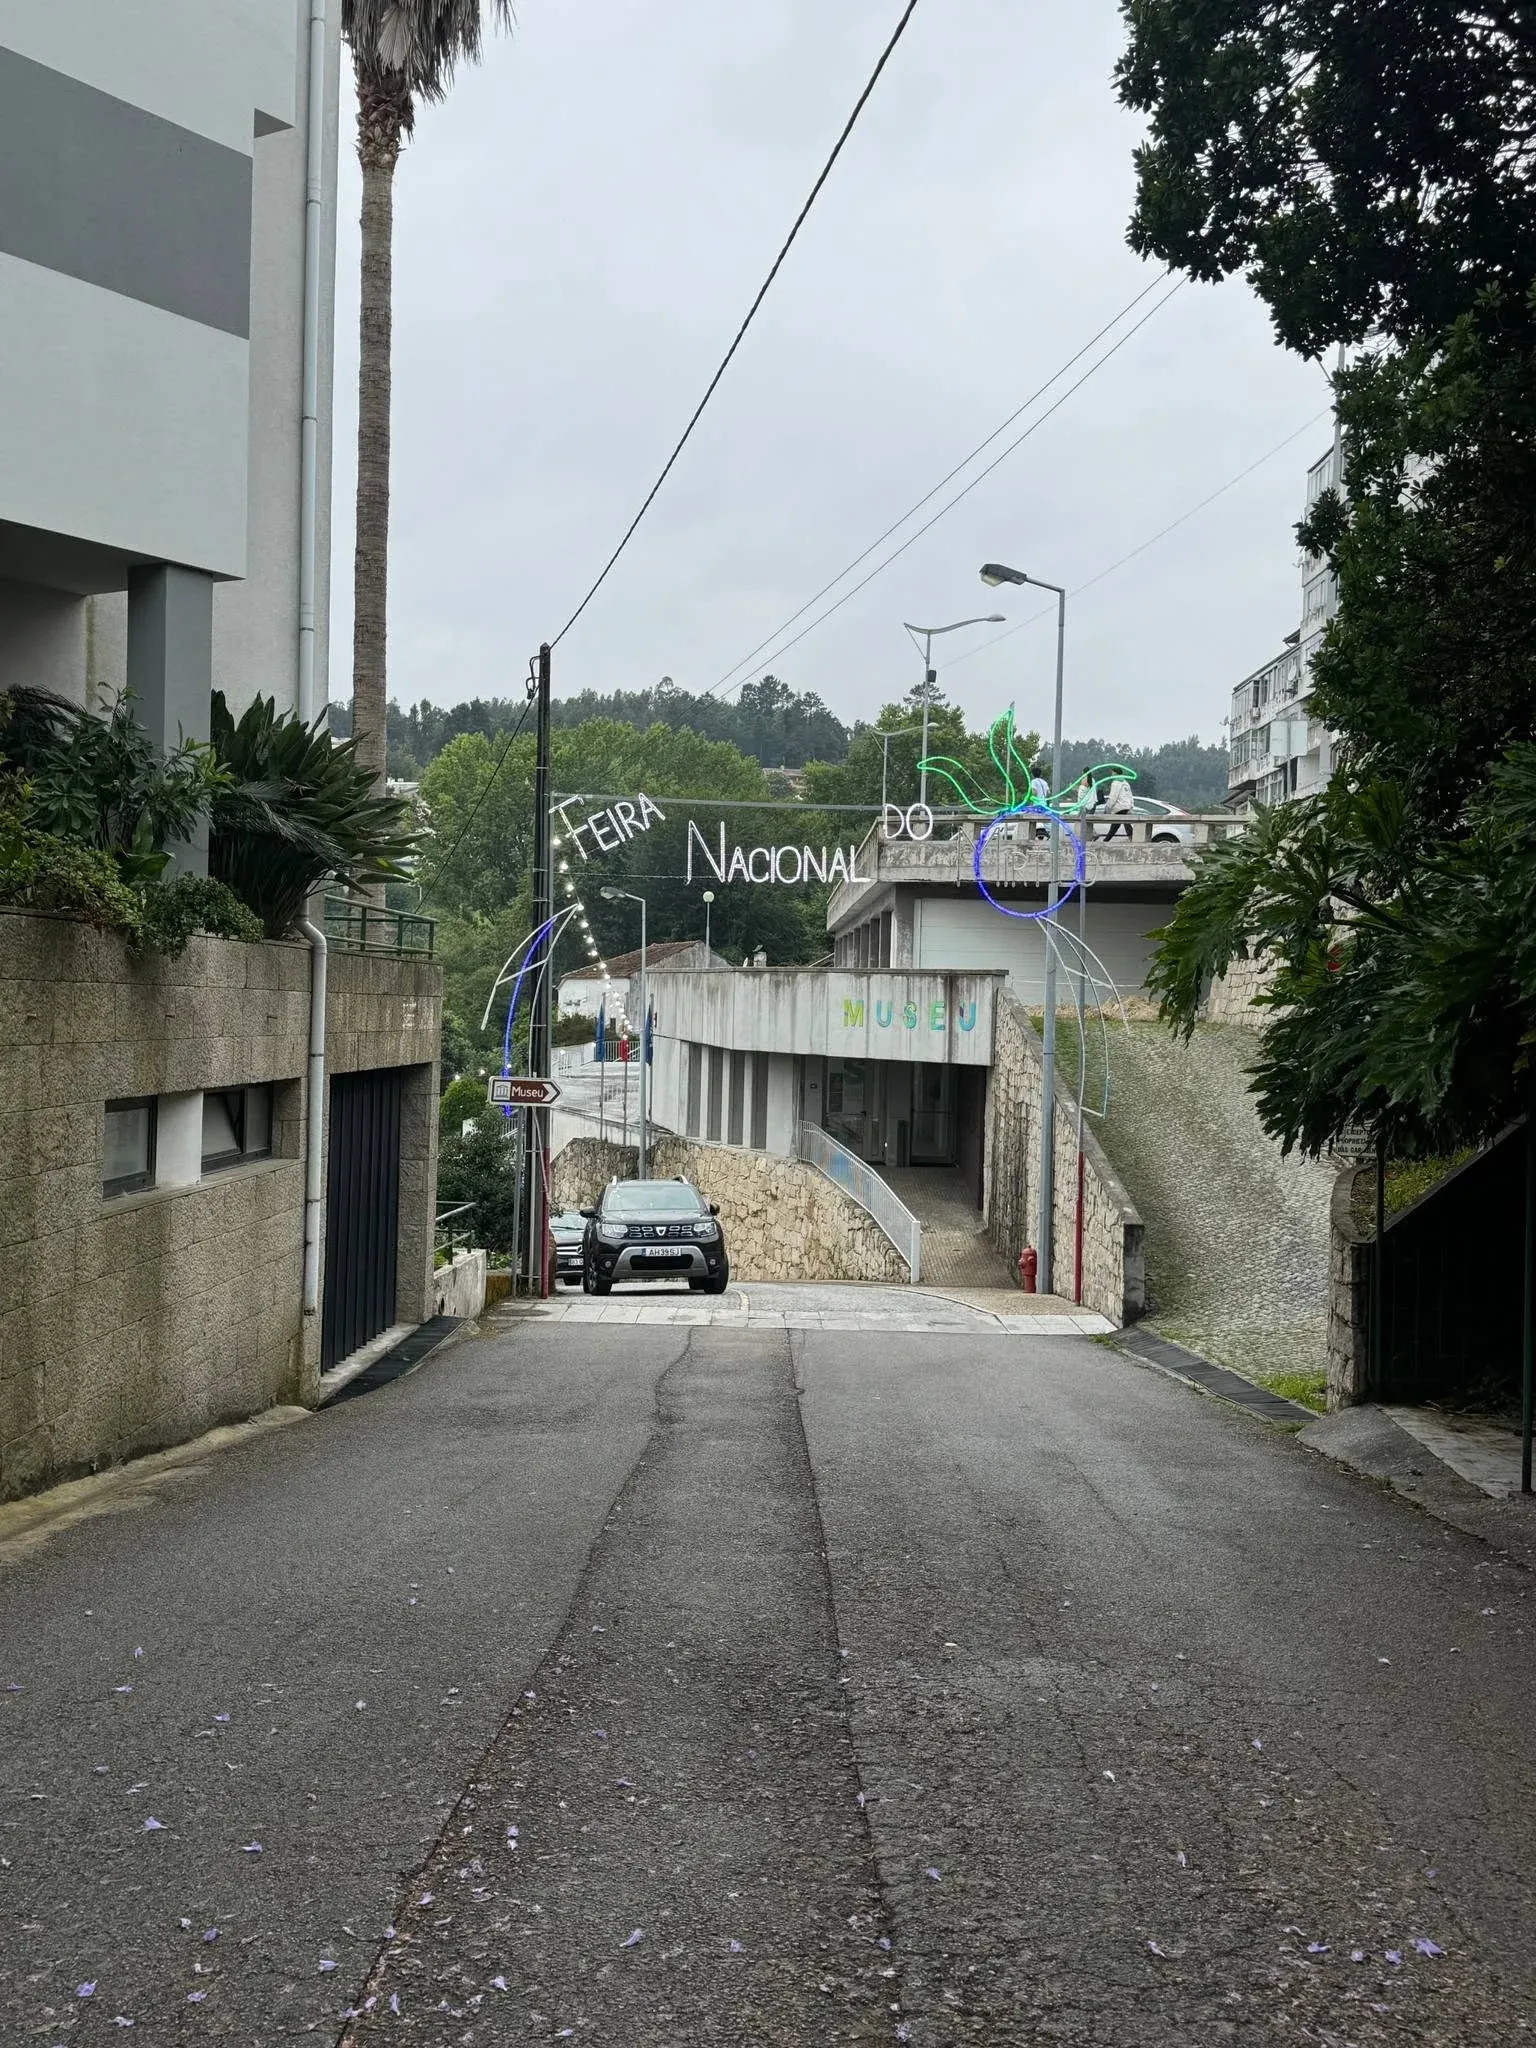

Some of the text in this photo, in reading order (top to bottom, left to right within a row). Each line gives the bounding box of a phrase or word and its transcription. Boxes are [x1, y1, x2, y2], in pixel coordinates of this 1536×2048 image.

[549, 793, 666, 861] FEIRA
[882, 802, 934, 841] DO
[684, 820, 872, 885] NACIONAL
[842, 995, 977, 1032] MUSEU
[511, 1085, 544, 1098] Museu
